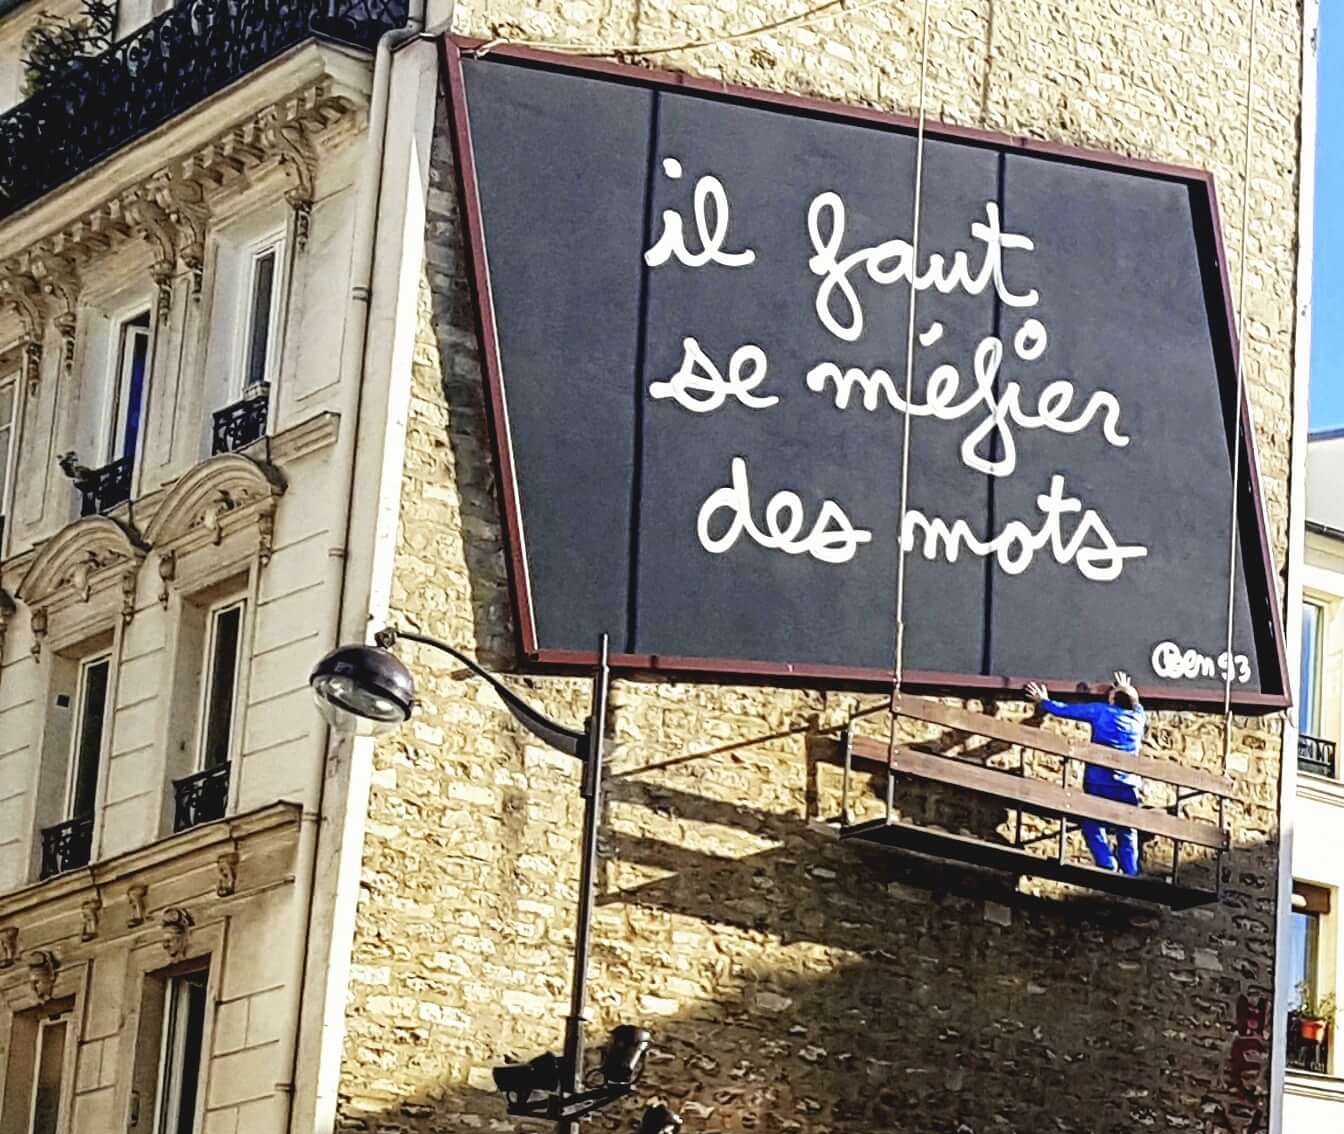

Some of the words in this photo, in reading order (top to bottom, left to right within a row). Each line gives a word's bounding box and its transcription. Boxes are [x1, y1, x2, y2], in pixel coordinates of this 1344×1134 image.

[643, 159, 756, 268] il
[807, 191, 1039, 342] faut
[648, 338, 779, 411] se
[696, 458, 871, 562] des
[901, 474, 1148, 581] mots
